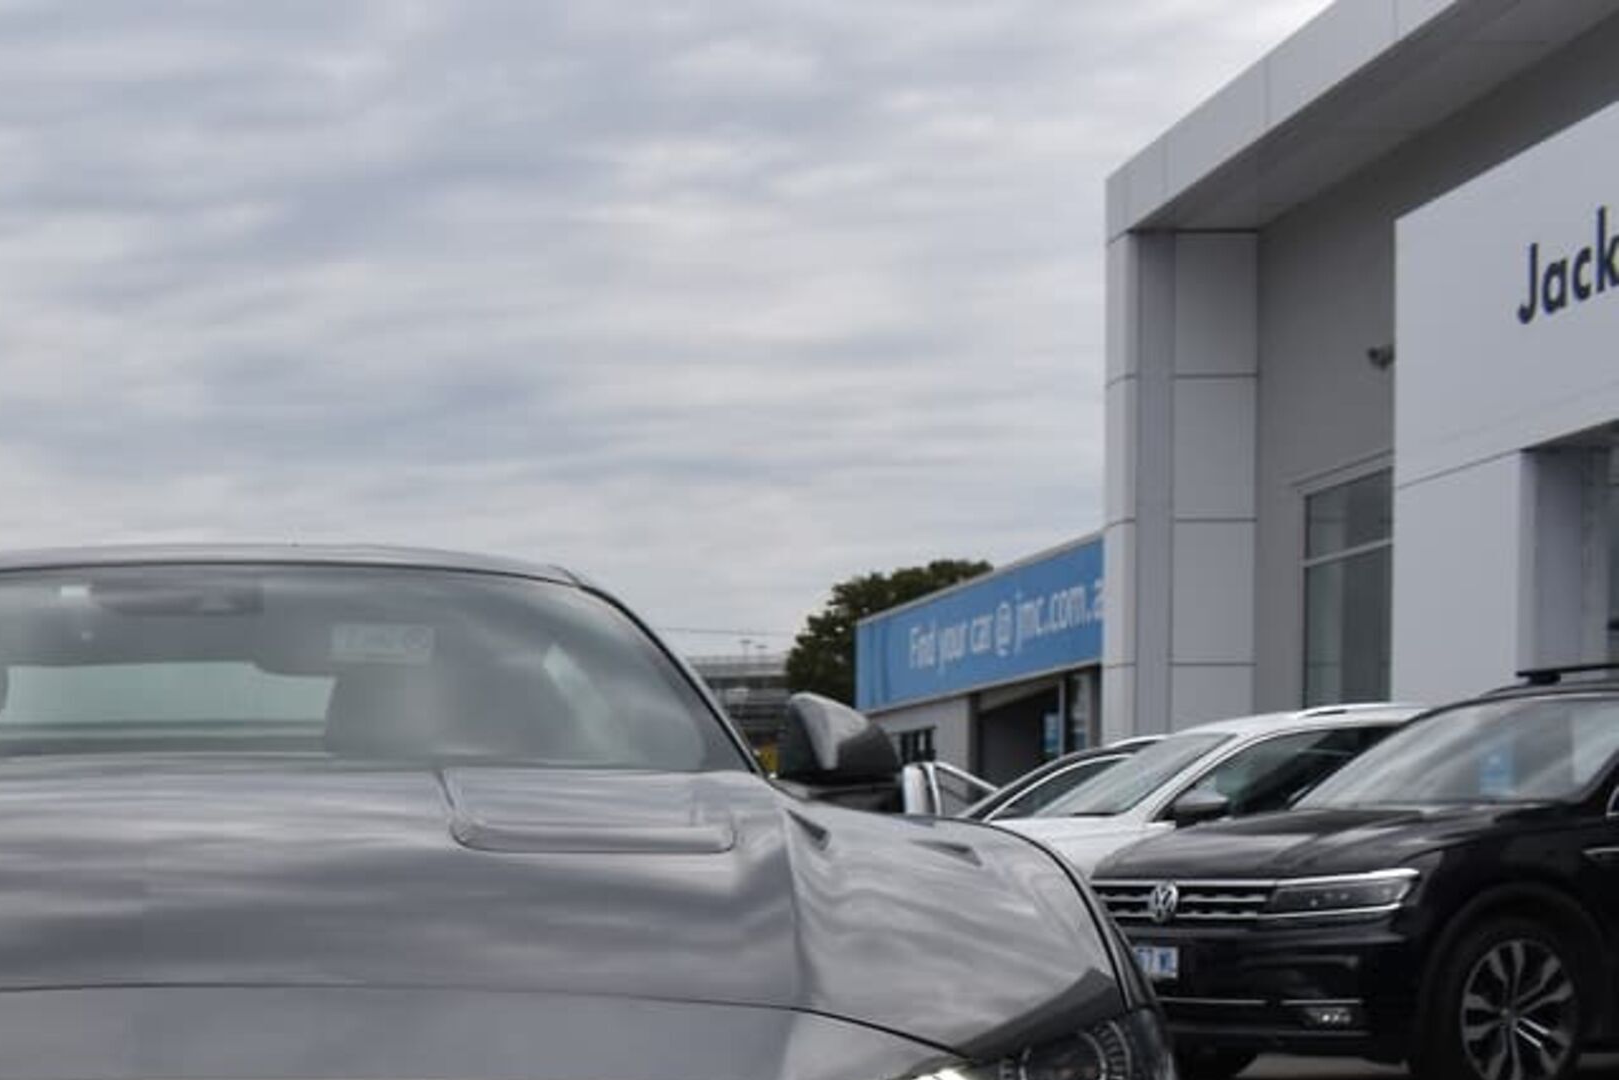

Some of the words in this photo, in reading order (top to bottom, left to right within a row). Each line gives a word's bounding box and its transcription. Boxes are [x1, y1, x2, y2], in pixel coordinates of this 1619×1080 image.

[1518, 205, 1619, 324] Jack
[909, 617, 936, 669] Find
[937, 622, 968, 675] your
[970, 614, 994, 653] car
[994, 602, 1013, 657] @
